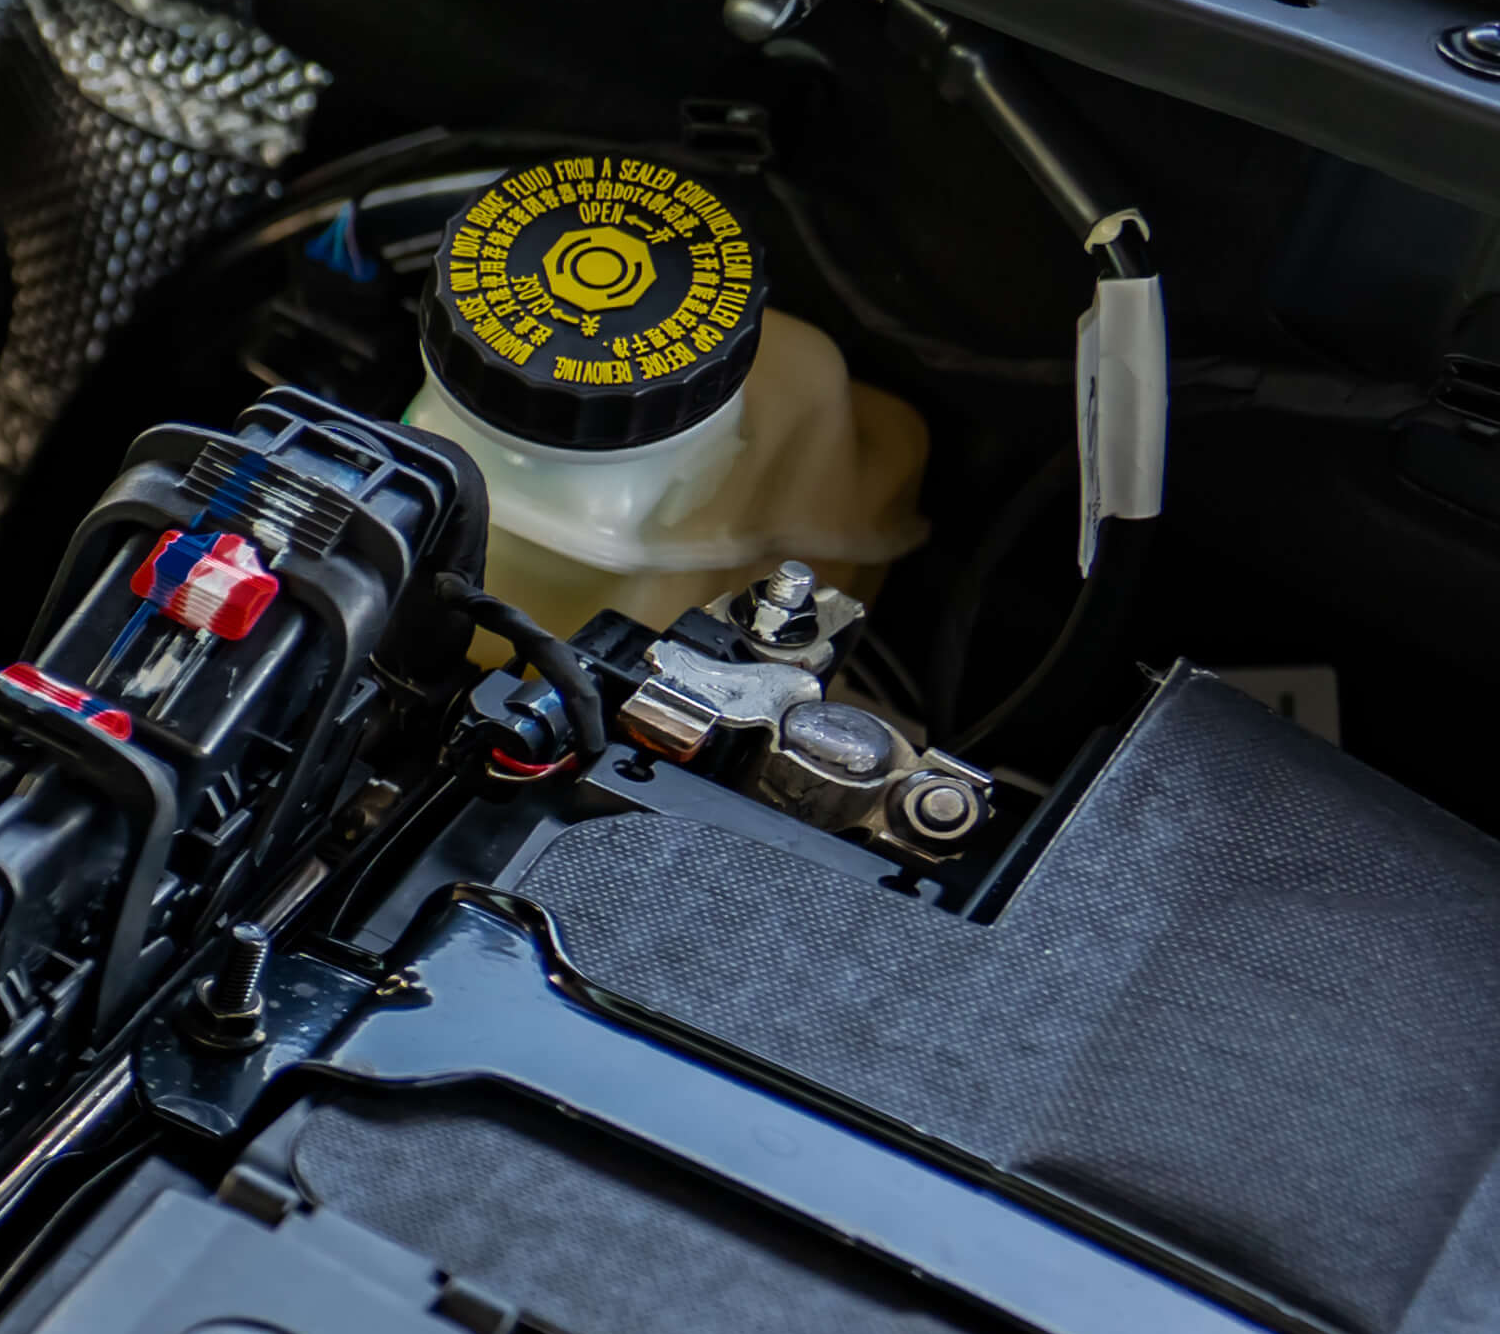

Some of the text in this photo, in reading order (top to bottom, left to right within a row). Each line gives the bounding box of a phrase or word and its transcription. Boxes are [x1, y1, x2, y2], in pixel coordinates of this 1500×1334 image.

[503, 166, 552, 199] FLUID
[554, 158, 594, 181] FROM
[602, 158, 611, 177] A
[620, 159, 676, 190] SEALED
[467, 190, 512, 227] BRAKE
[580, 202, 675, 244] OPEN 开
[452, 227, 484, 257] DOT4
[450, 261, 479, 291] ONLY
[721, 241, 752, 279] CLEAN
[510, 273, 602, 337] 关 CLOSE
[707, 282, 751, 328] FILLER
[692, 325, 724, 352] CAP
[636, 342, 697, 378] BEFORE
